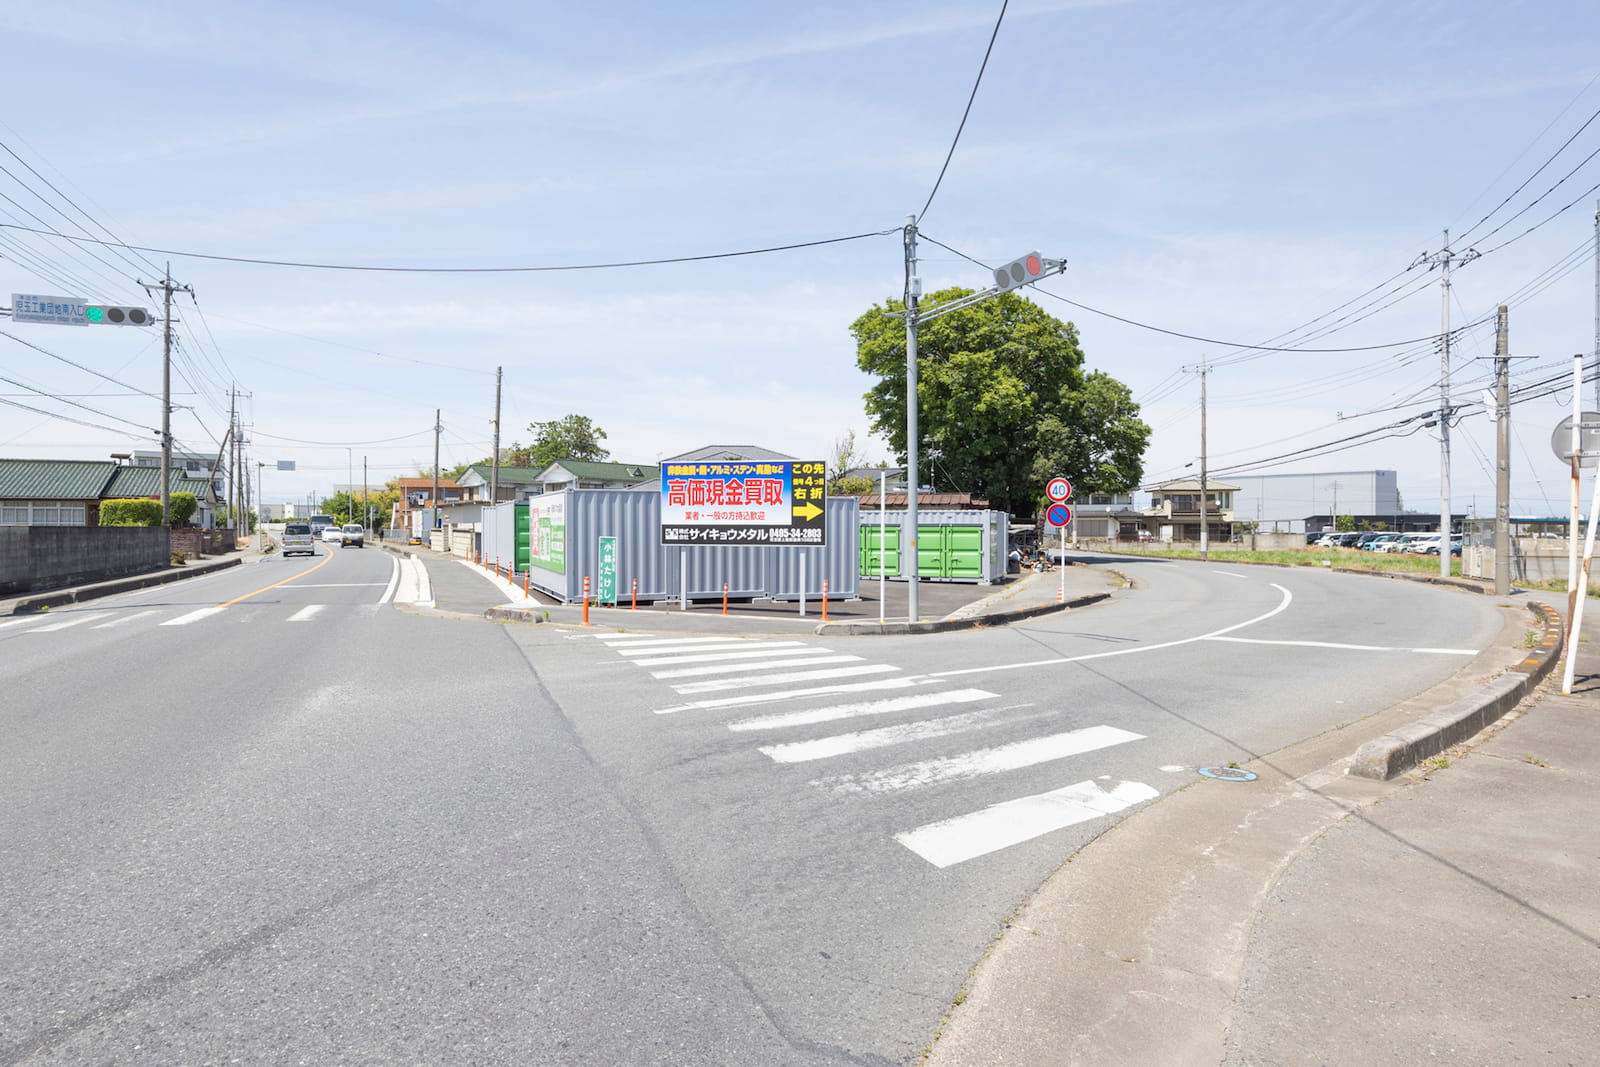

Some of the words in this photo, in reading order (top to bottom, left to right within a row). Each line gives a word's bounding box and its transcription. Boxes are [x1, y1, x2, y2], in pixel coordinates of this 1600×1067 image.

[16, 300, 84, 316] 児玉工業団地南入口
[792, 463, 824, 474] この先
[667, 478, 783, 506] 高価現金買取
[794, 487, 823, 499] 右折
[1052, 485, 1066, 495] 40
[685, 511, 765, 520] 業者・一般の方持込歓迎
[689, 528, 768, 541] サイキョウメタル
